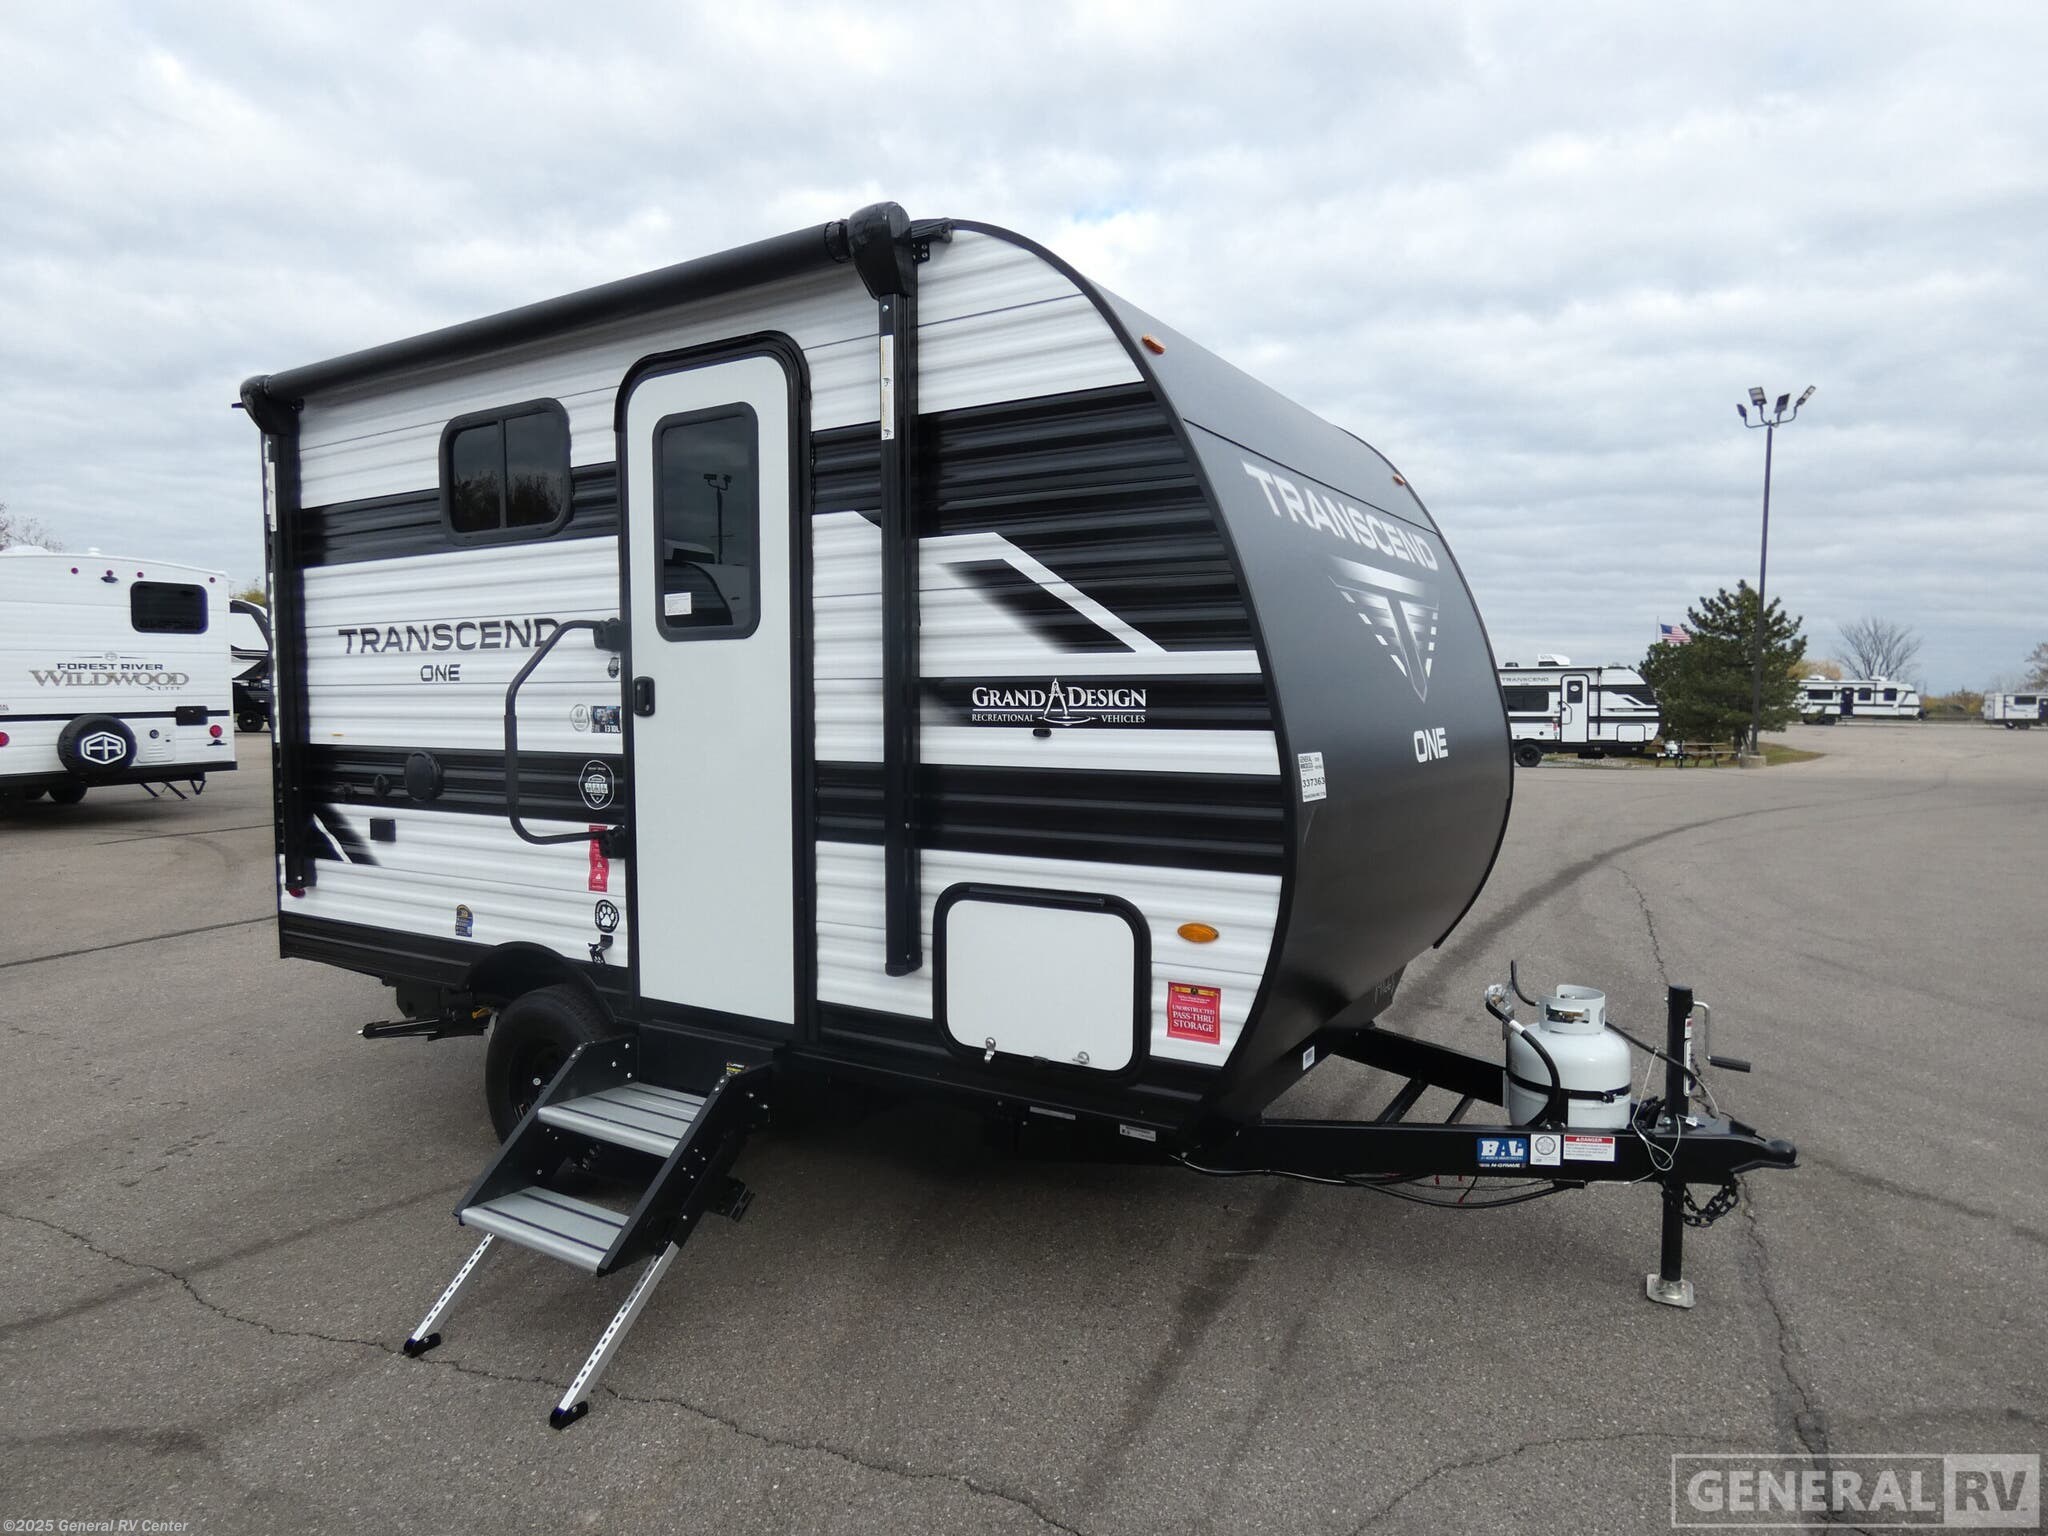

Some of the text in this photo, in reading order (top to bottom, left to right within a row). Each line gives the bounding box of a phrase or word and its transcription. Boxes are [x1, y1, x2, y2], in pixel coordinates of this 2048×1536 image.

[1242, 460, 1439, 571] TRANSCEND
[338, 618, 560, 654] TRANSCEND
[57, 663, 164, 671] FOREST RIVER
[420, 664, 461, 682] ONE
[29, 670, 190, 687] WILDWOOD
[972, 686, 1147, 707] GRAND DESIGN
[971, 713, 1146, 723] RECREATIONAL VEHICLES
[1413, 727, 1449, 763] ONE
[1303, 776, 1327, 787] 337363
[1172, 1011, 1215, 1024] PASS-THRU
[1173, 1020, 1215, 1032] STORAGE
